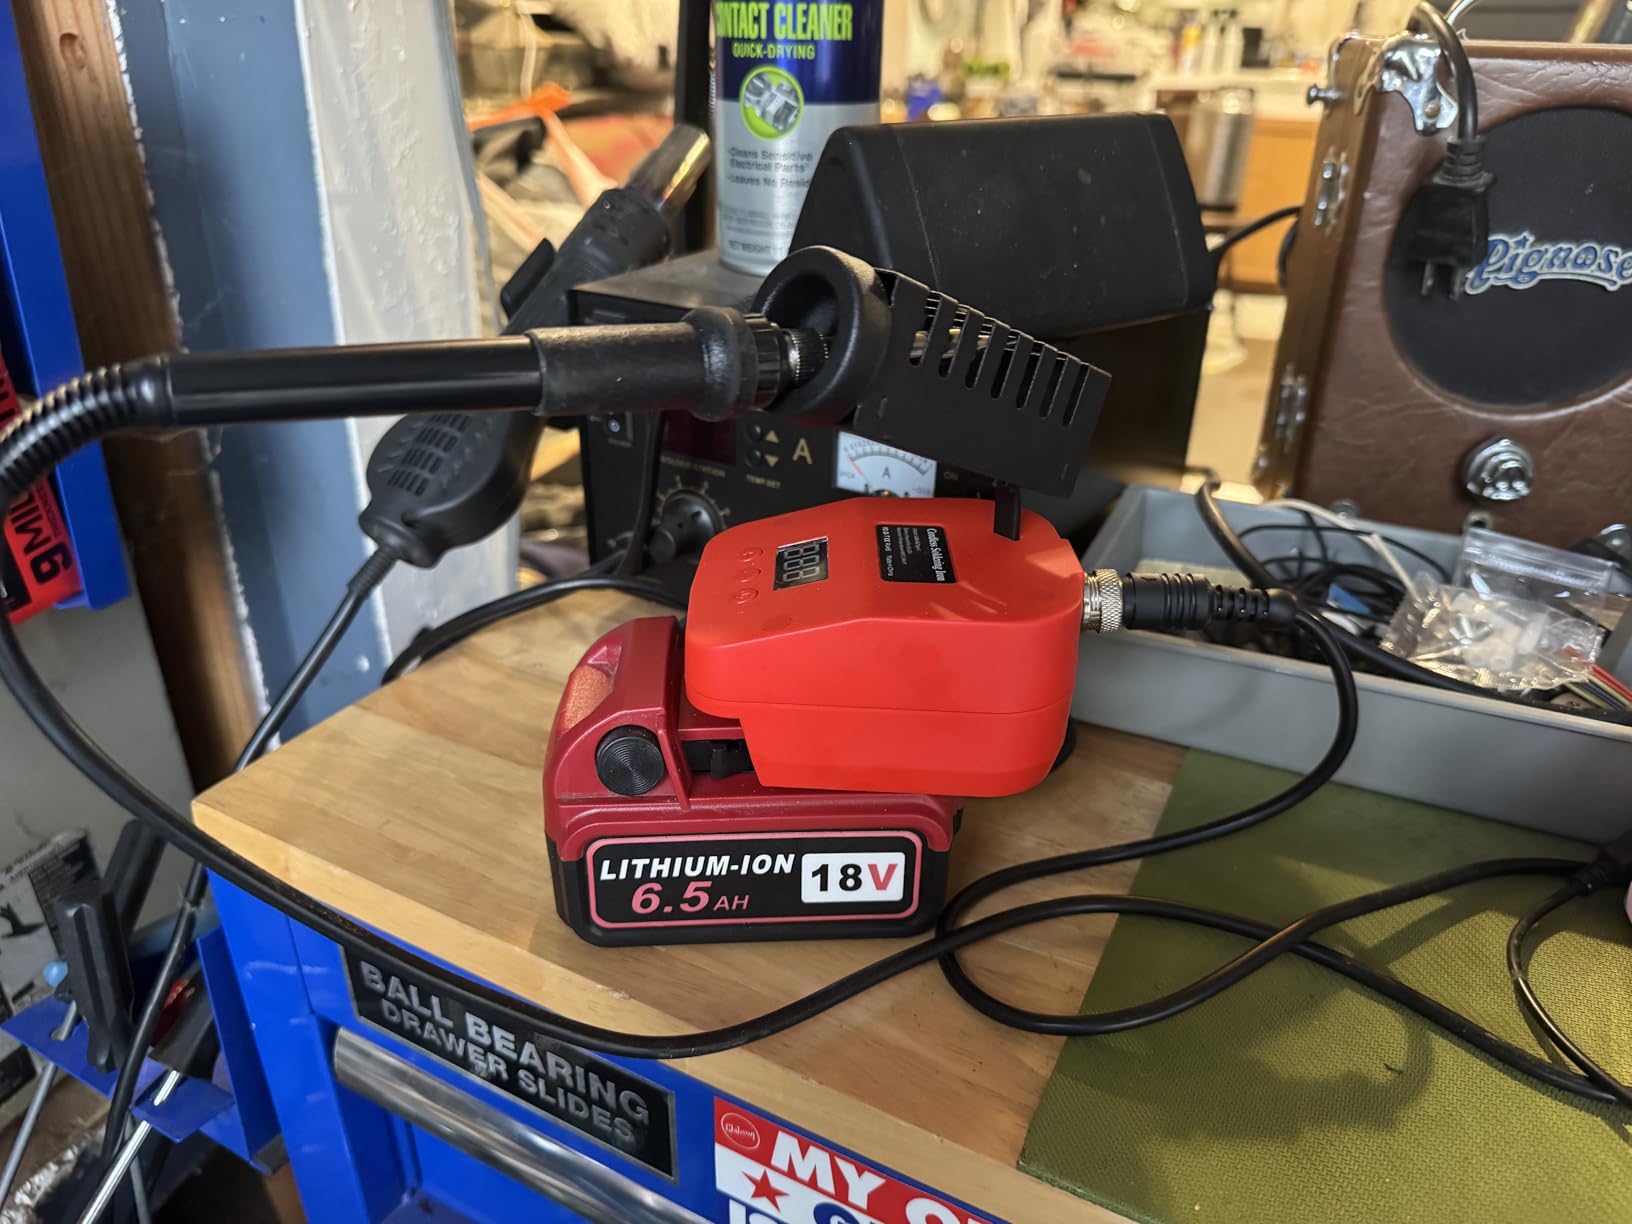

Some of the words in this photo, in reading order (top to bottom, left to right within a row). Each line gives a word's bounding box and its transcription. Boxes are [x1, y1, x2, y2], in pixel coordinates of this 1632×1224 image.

[773, 2, 853, 41] CLEANER
[731, 43, 816, 60] QUICK-DRYING
[1465, 231, 1632, 295] Pignose
[792, 437, 813, 465] A
[926, 528, 939, 548] Cordless
[930, 547, 945, 570] Soldering
[935, 570, 947, 582] Iron
[600, 853, 795, 881] LITHIUM-ION
[811, 863, 897, 893] 18V
[360, 960, 454, 1027] BALL
[465, 1011, 649, 1125] BEARING
[381, 999, 509, 1081] DRAWER
[519, 1068, 636, 1142] SLIDES
[770, 1130, 886, 1210] MY
